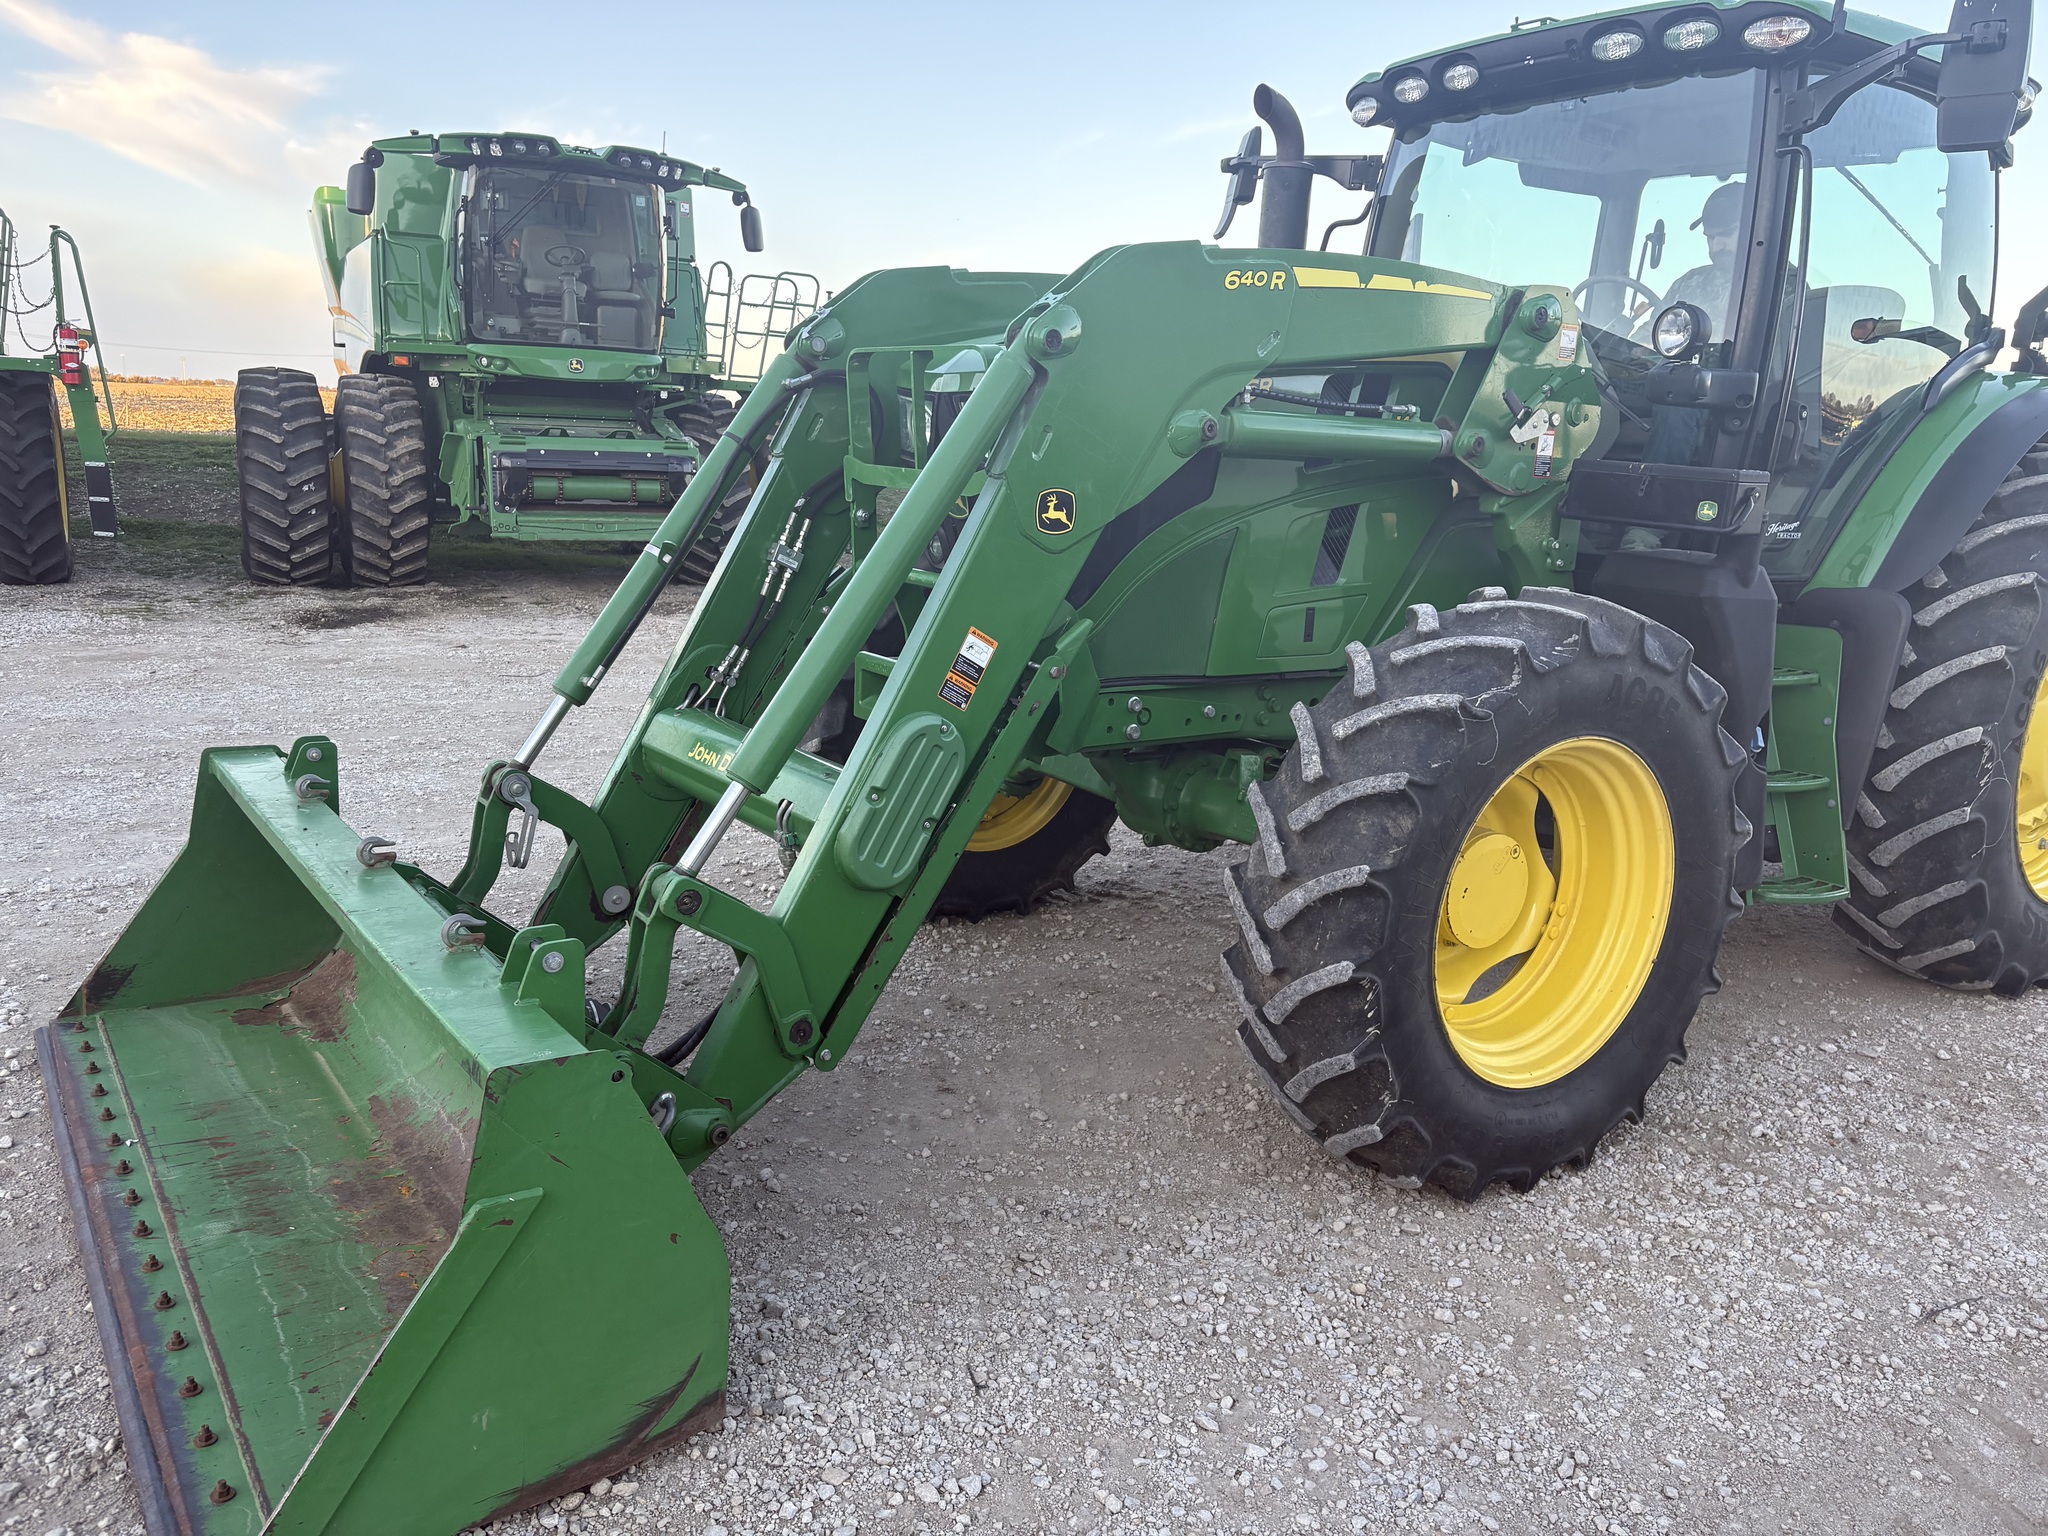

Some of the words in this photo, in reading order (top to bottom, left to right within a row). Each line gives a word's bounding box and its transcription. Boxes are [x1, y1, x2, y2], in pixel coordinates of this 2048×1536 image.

[1765, 521, 1800, 537] Heritage
[976, 632, 995, 647] WARNING
[954, 677, 973, 692] WARNING
[688, 742, 721, 767] JOHN
